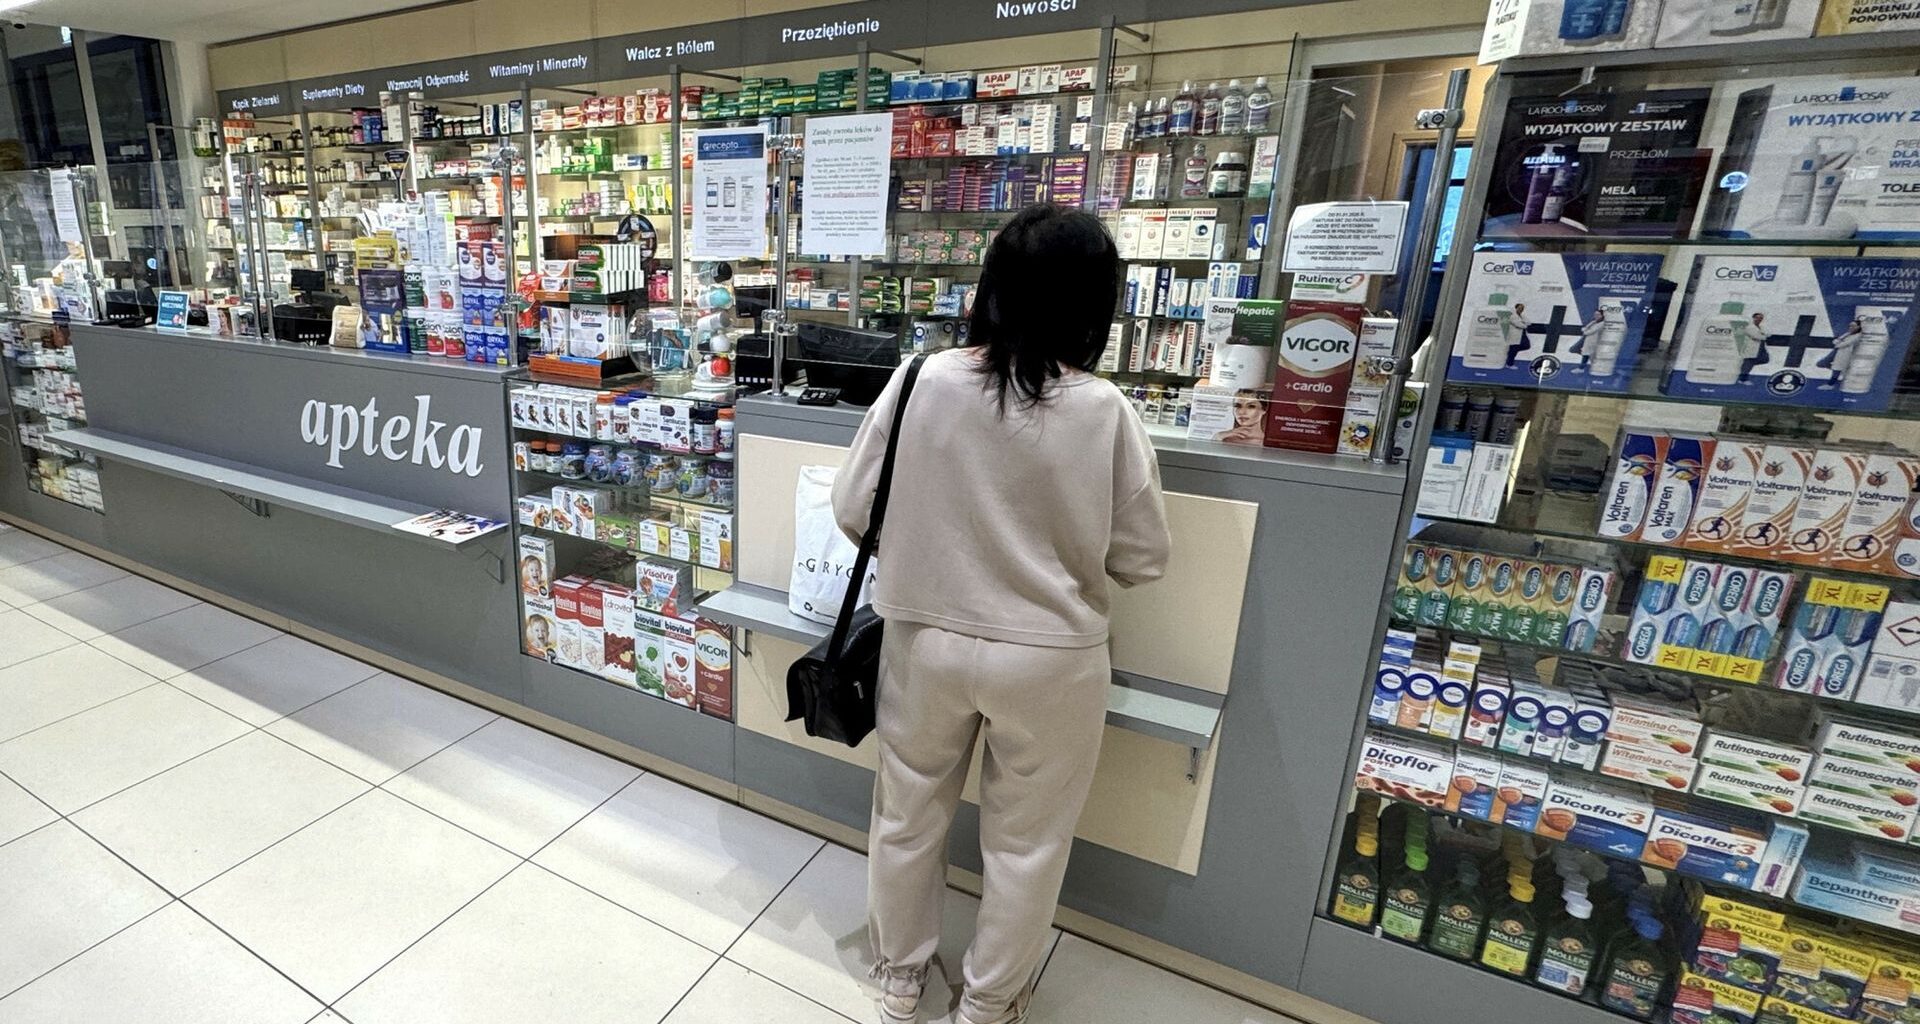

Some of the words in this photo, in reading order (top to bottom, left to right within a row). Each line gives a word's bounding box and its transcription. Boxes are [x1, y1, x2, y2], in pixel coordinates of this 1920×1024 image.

[781, 17, 881, 44] Przeziębienie
[626, 45, 662, 63] Walcz
[664, 45, 673, 57] z
[675, 38, 716, 56] Bólem
[489, 61, 534, 78] Witaminy
[536, 60, 541, 73] i
[543, 55, 589, 73] Minerały
[1064, 69, 1087, 78] APAP
[386, 75, 424, 92] Wzmocnij
[425, 71, 470, 88] Odporność
[983, 73, 1012, 84] APAP
[302, 86, 344, 101] Suplementy
[345, 83, 366, 97] Diety
[252, 95, 281, 107] Zielarski
[1524, 121, 1619, 136] WYJĄTKOWY
[1620, 119, 1688, 132] ZESTAW
[1789, 111, 1906, 127] WYJĄTKOWY
[1609, 149, 1669, 160] PRZEŁOM
[1601, 185, 1637, 195] MELA
[1483, 260, 1535, 277] CeraVe
[1580, 262, 1653, 274] WYJĄTKOWY
[1715, 265, 1779, 281] CeraVe
[1298, 274, 1341, 284] Rutinex
[1344, 276, 1353, 284] C
[1601, 272, 1650, 282] ZESTAW
[1859, 278, 1918, 290] ZESTAW
[1211, 304, 1276, 317] SanoHepatic
[1286, 336, 1350, 354] VIGOR
[1285, 381, 1333, 394] +cardio
[300, 395, 484, 478] apteka
[1706, 482, 1729, 491] Sport
[1709, 475, 1752, 487] Voltaren
[1756, 480, 1801, 492] Voltaren
[1754, 488, 1777, 497] Sport
[1803, 493, 1828, 502] Sport
[1806, 485, 1853, 498] Voltaren
[1858, 490, 1907, 504] Voltaren
[1606, 481, 1631, 522] Voltaren
[1649, 486, 1675, 528] Voltaren
[1856, 499, 1880, 508] Sport
[1620, 506, 1632, 521] MAX
[1664, 511, 1677, 527] MAX
[1662, 563, 1678, 577] XL
[1584, 578, 1602, 608] COREGA
[1688, 568, 1711, 602] COREGA
[1722, 573, 1746, 608] COREGA
[1826, 585, 1842, 600] XL
[1759, 578, 1784, 614] COREGA
[1864, 590, 1882, 605] XL
[526, 600, 553, 612] sanostol
[1406, 597, 1418, 616] MAX
[1434, 602, 1447, 621] MAX
[635, 613, 662, 628] biovital
[1462, 606, 1475, 625] MAX
[1490, 612, 1503, 632] MAX
[664, 620, 693, 636] biovital
[1518, 617, 1533, 637] MAX
[1548, 621, 1563, 641] MAX
[1633, 625, 1653, 658] COREGA
[1664, 650, 1678, 664] XL
[1699, 656, 1713, 669] XL
[1733, 662, 1749, 675] XL
[1788, 652, 1811, 686] COREGA
[1826, 657, 1850, 692] COREGA
[1616, 713, 1667, 731] Witamina
[1667, 724, 1678, 732] C
[1837, 729, 1920, 754] Rutinoscorb
[1365, 747, 1439, 773] Dicoflor
[1612, 748, 1663, 765] Witamina
[1663, 759, 1673, 767] C
[1714, 739, 1802, 765] Rutinoscorbin
[1363, 757, 1396, 769] FORTE
[1456, 761, 1496, 776] Dicoflor
[1501, 772, 1542, 788] Dicoflor
[1709, 770, 1795, 797] Rutinoscorbin
[1824, 761, 1919, 790] Rutinoscorbin
[1550, 794, 1627, 820] Dicoflor
[1627, 811, 1646, 826] 3
[1812, 793, 1906, 822] Rutinoscorbin
[1659, 824, 1737, 851] Dicoflor
[1737, 842, 1757, 857] 3
[1867, 866, 1920, 885] Bepanth
[1807, 875, 1900, 907] Bepanthen
